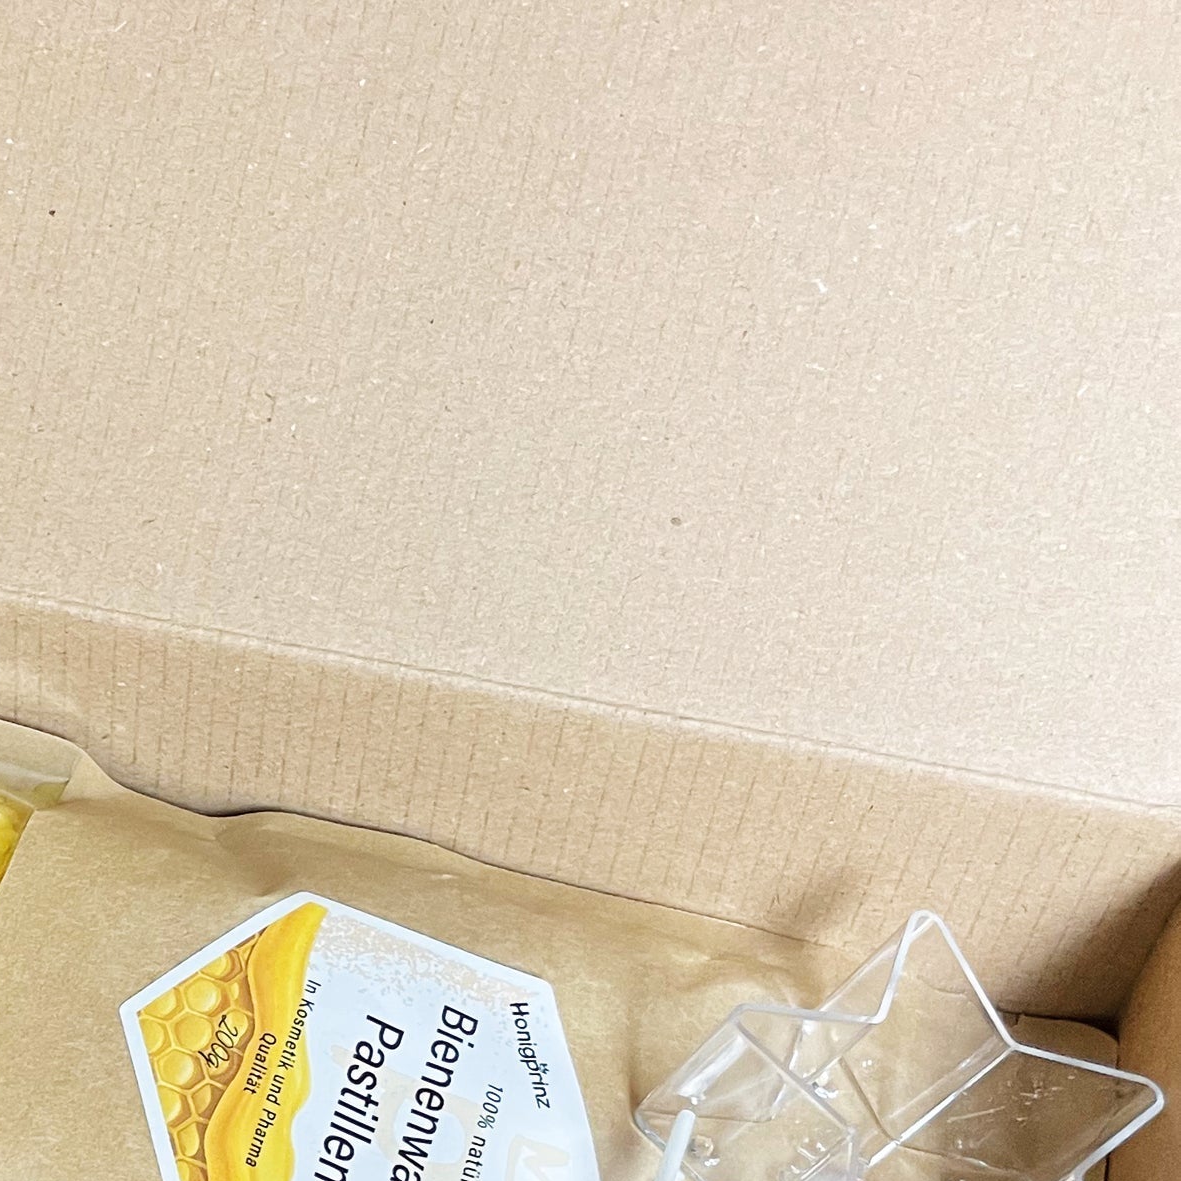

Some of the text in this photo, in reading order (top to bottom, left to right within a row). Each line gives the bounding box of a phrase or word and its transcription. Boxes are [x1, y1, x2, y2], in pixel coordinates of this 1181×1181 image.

[198, 1014, 238, 1069] 200g
[243, 1032, 277, 1095] Qualität
[510, 1002, 550, 1109] Honigprinz
[246, 979, 322, 1168] In Kosmetik und Pharma
[477, 1083, 504, 1130] 100%
